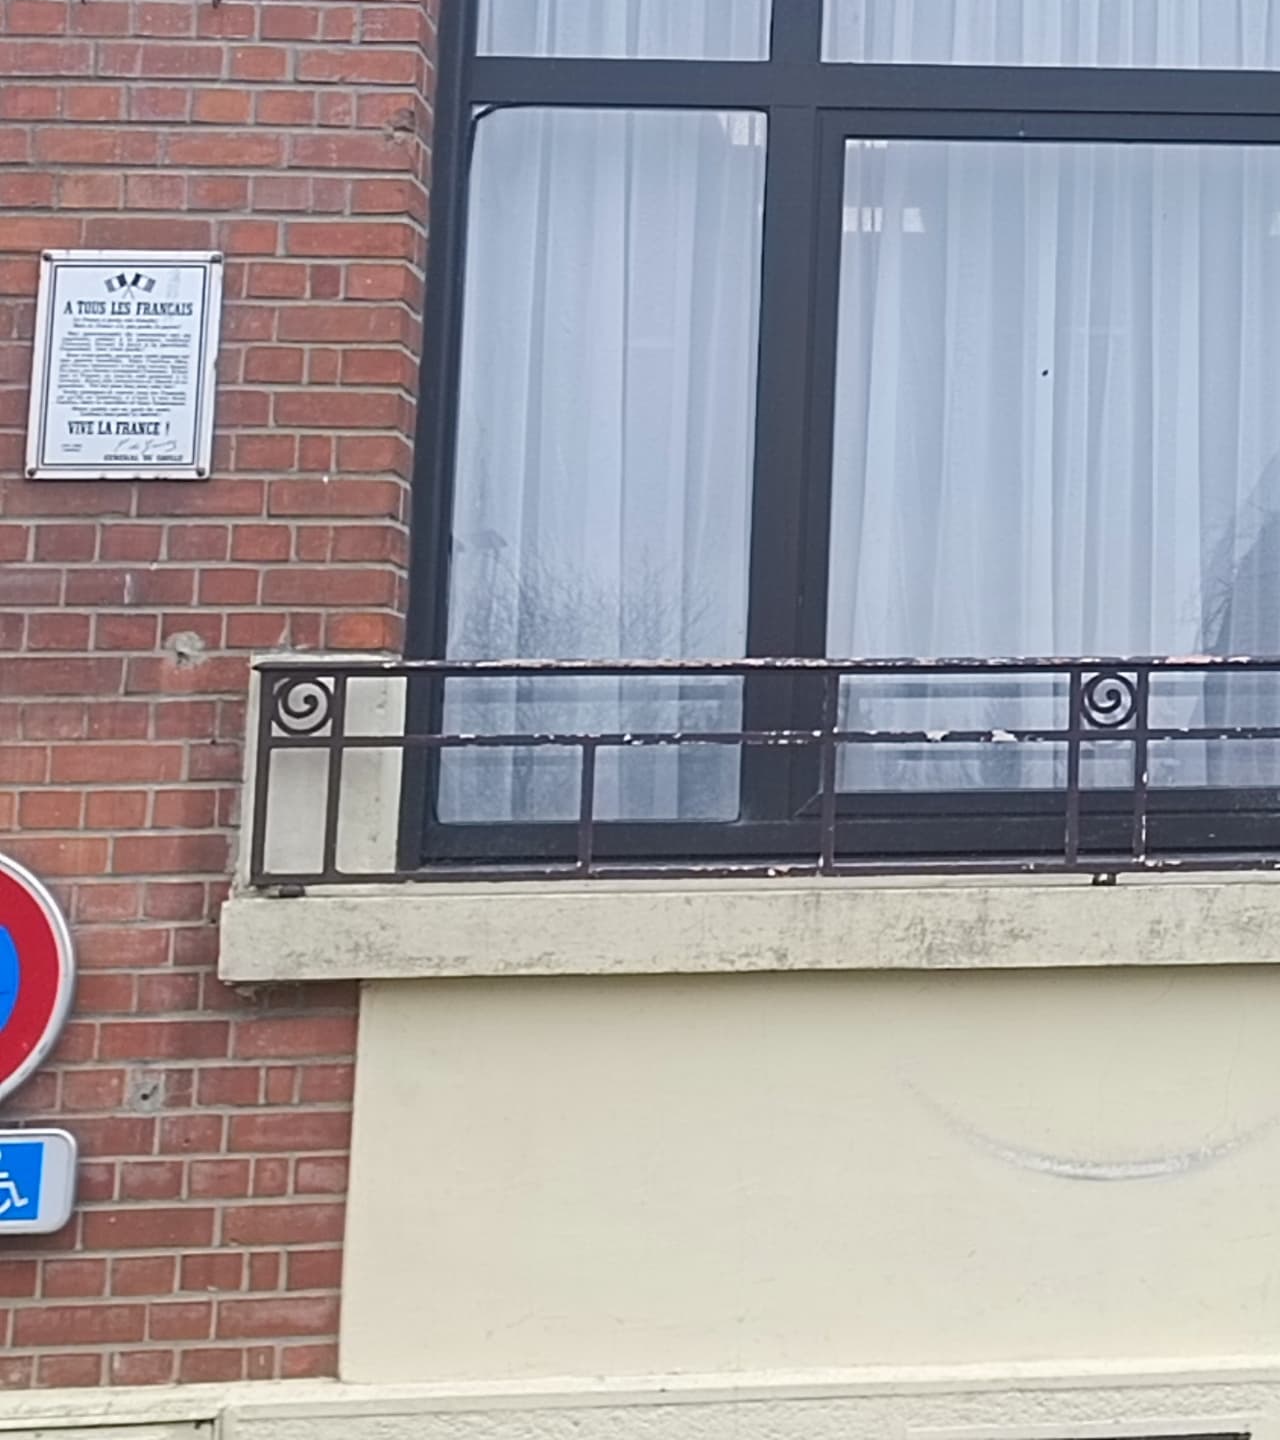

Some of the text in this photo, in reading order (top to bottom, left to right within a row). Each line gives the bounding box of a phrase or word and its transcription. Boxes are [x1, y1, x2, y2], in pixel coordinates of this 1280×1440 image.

[64, 301, 73, 315] A
[77, 301, 106, 315] TOUS
[111, 301, 131, 315] LES
[68, 421, 94, 435] VIVE
[98, 421, 112, 435] LA
[116, 421, 160, 435] FRANCE
